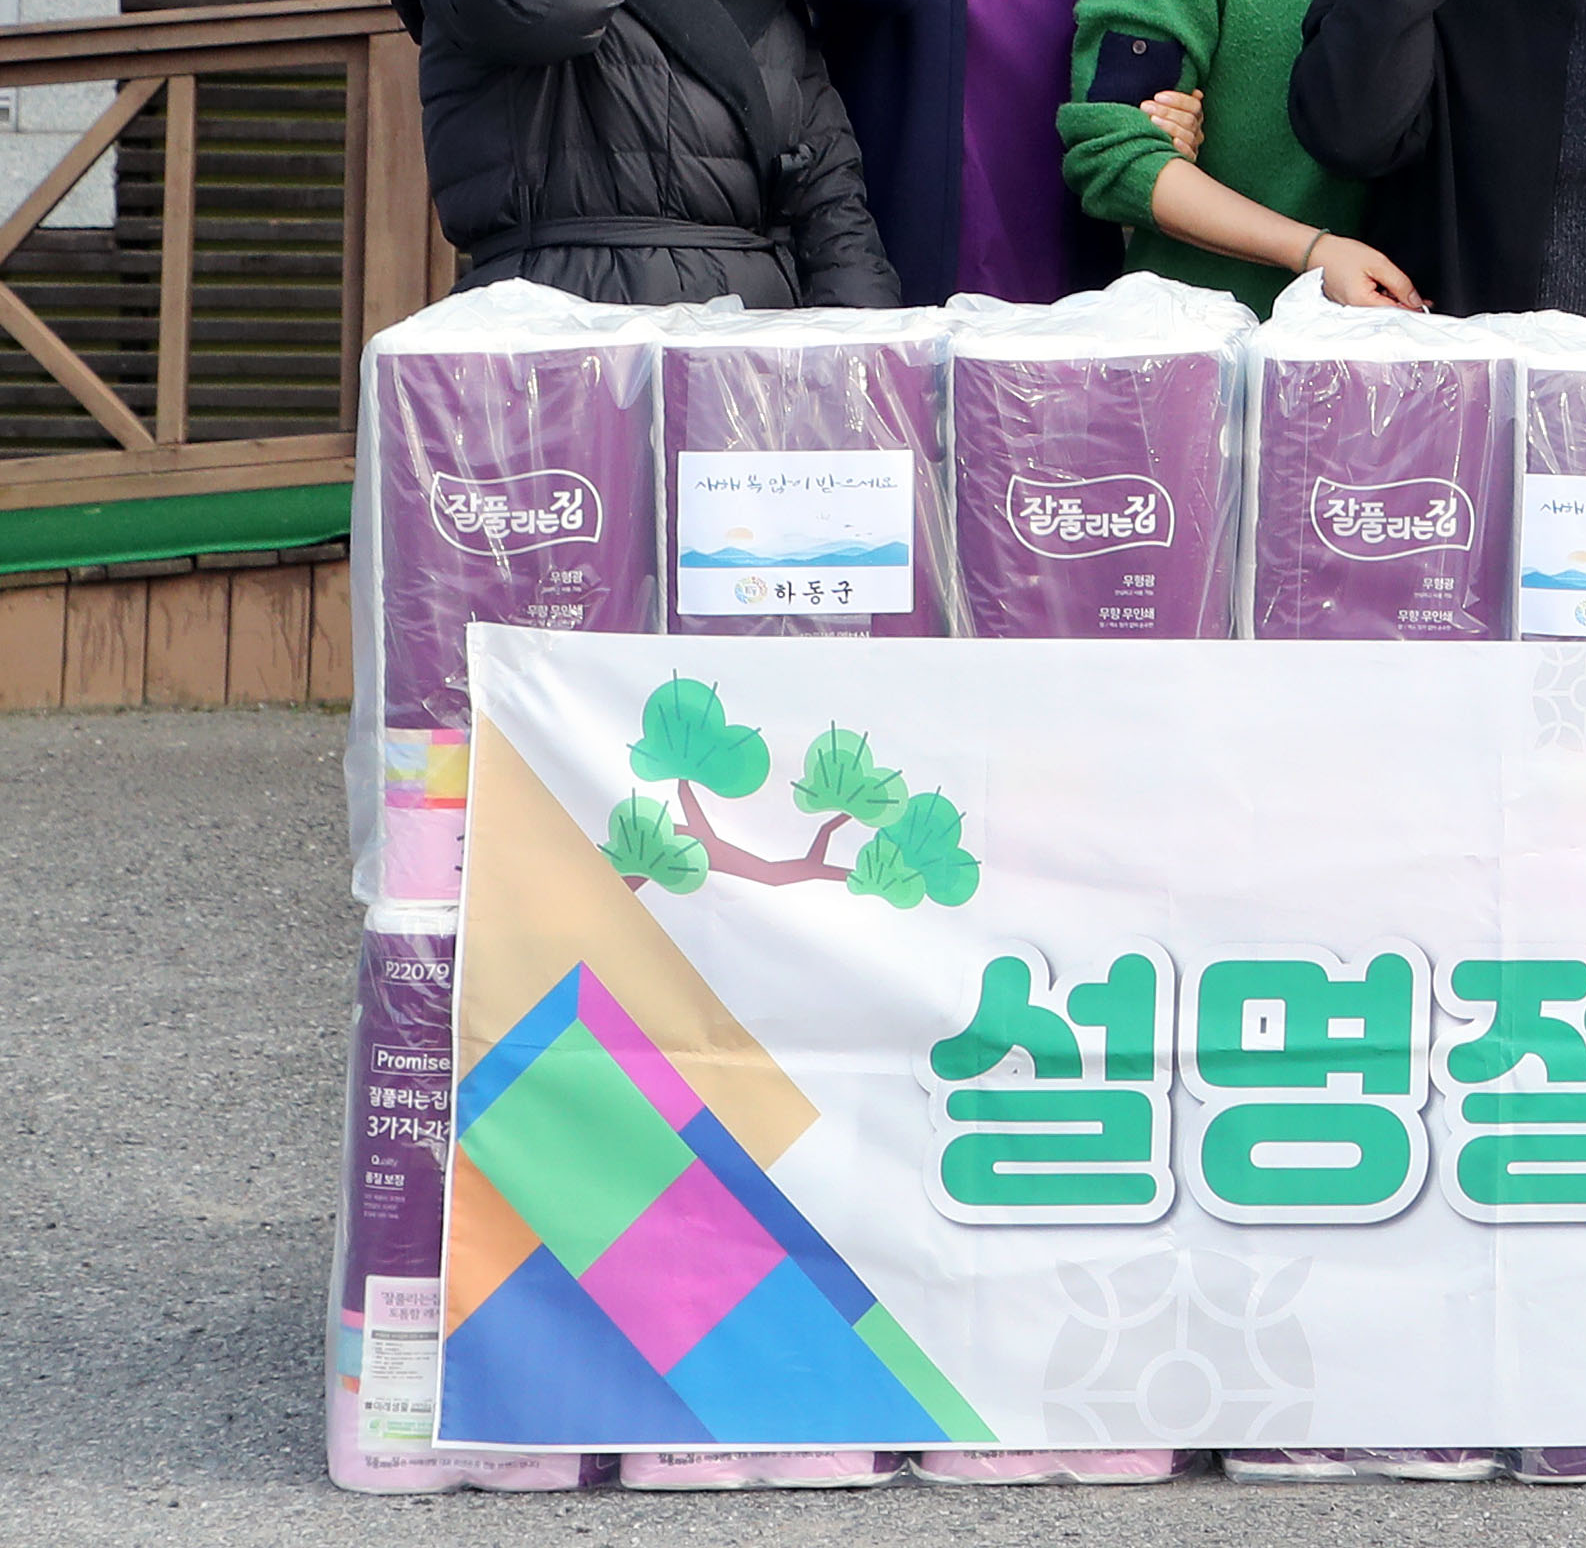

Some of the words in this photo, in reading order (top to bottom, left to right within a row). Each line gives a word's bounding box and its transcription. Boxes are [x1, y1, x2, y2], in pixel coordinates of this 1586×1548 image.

[695, 475, 742, 493] 새해
[746, 474, 763, 493] 복
[815, 473, 898, 494] 받으세요
[445, 488, 583, 540] 잘풀리는집
[1019, 494, 1156, 542] 잘풀리는집
[1323, 497, 1457, 544] 잘풀리는집
[1540, 499, 1585, 516] 새해
[774, 579, 854, 605] 하동군
[385, 960, 450, 981] P22079
[377, 1050, 451, 1071] Promise
[367, 1085, 452, 1113] 잘풀리는집
[366, 1115, 419, 1141] 3가지
